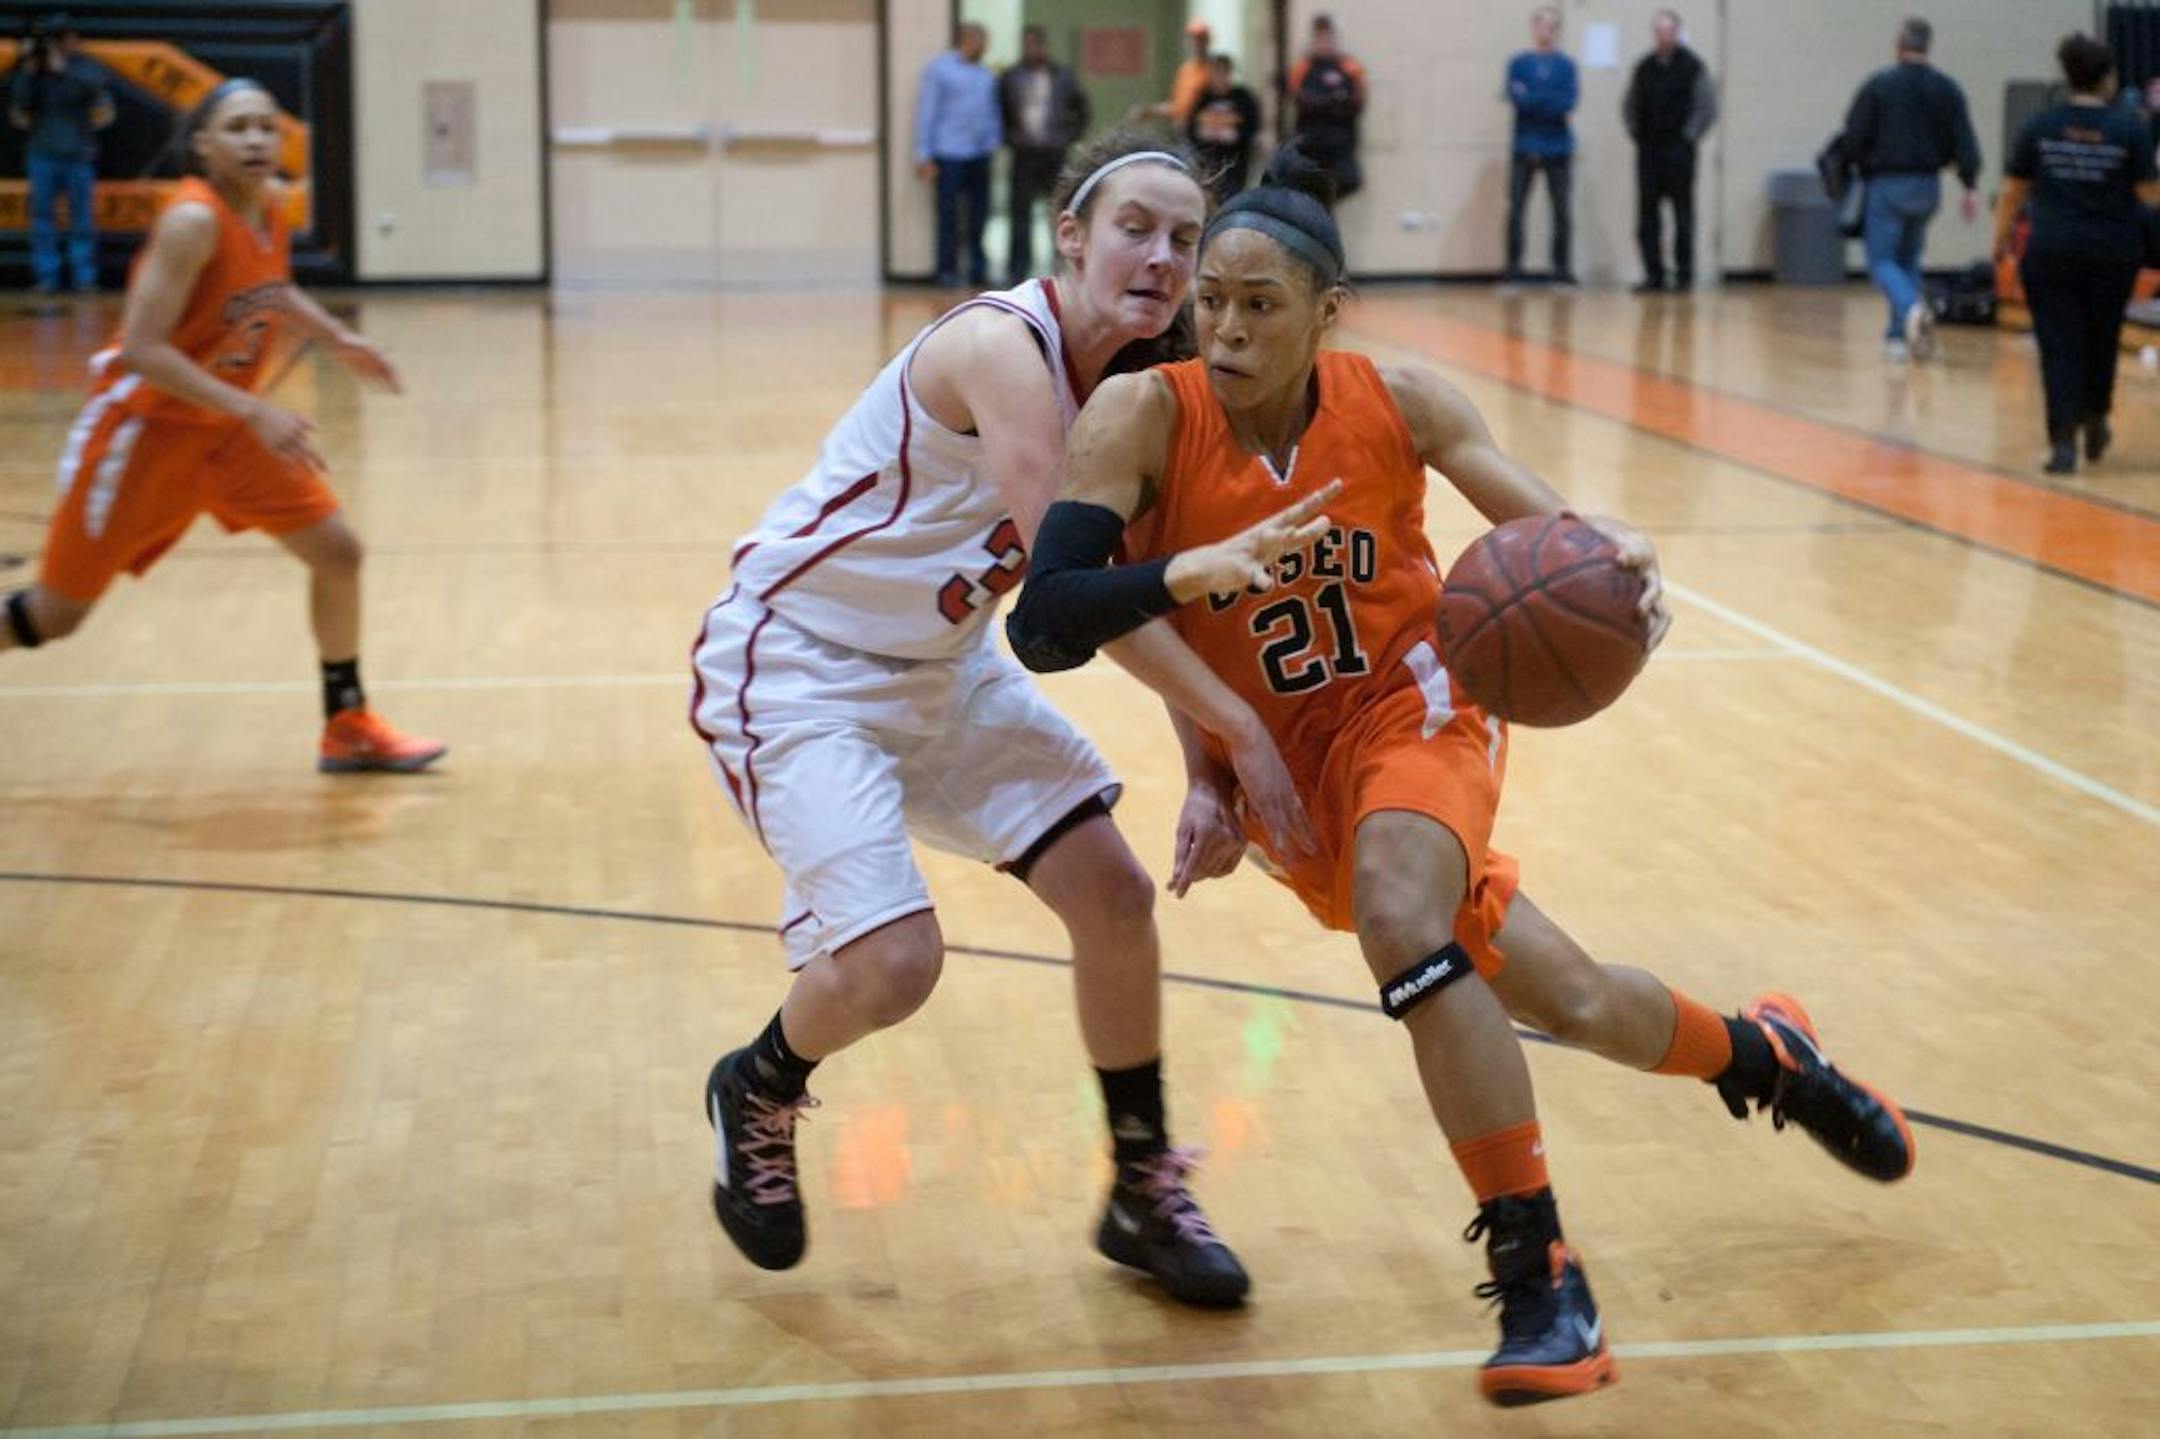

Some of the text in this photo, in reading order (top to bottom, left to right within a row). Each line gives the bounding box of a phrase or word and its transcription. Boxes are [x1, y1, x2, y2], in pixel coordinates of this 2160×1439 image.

[1206, 525, 1377, 613] SEO
[1249, 578, 1372, 696] 21
[1388, 958, 1453, 1008] Mueller
